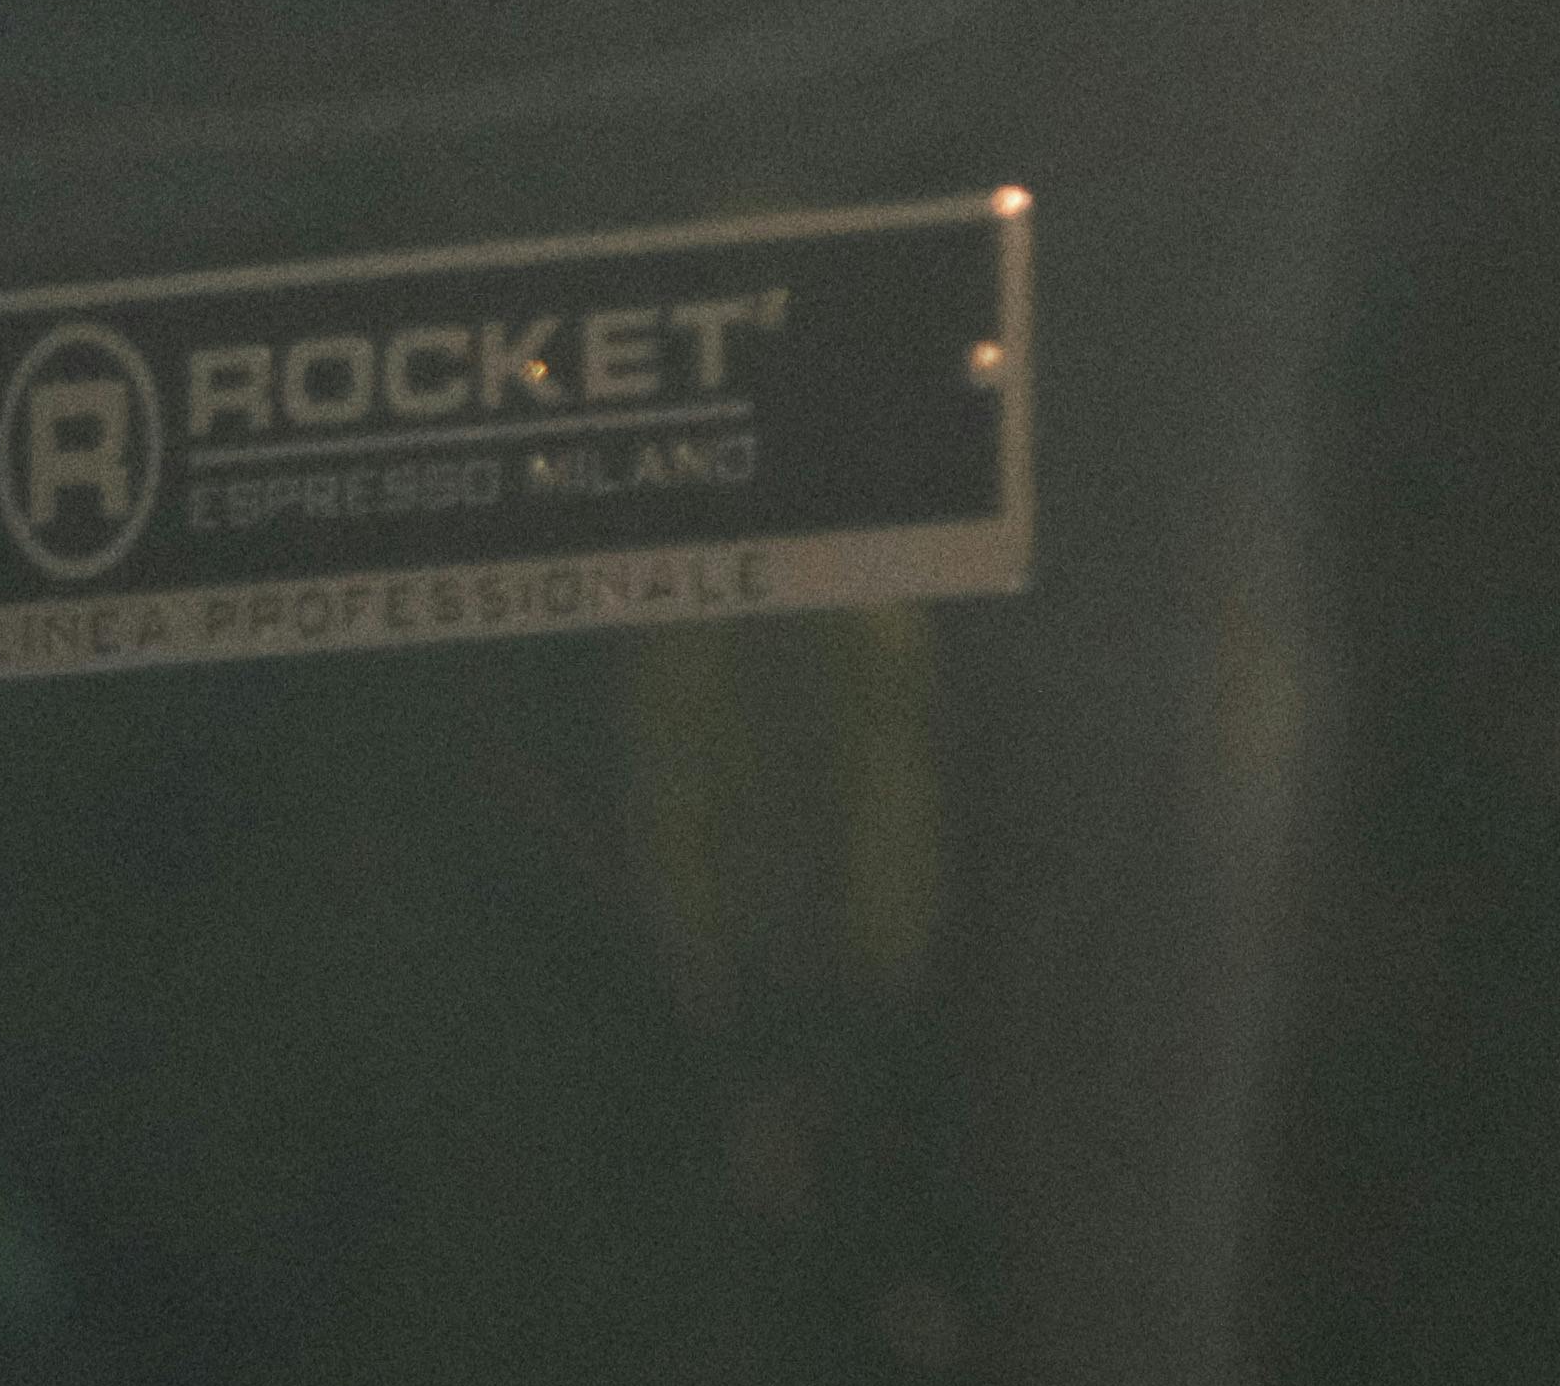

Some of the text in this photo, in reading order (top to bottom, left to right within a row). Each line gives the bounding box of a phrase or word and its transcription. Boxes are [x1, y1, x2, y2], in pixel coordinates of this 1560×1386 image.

[187, 299, 758, 437] ROCKET
[27, 379, 130, 525] R
[188, 433, 757, 533] ESPRESSO MILANO
[205, 550, 773, 639] PROFESSIONALE
